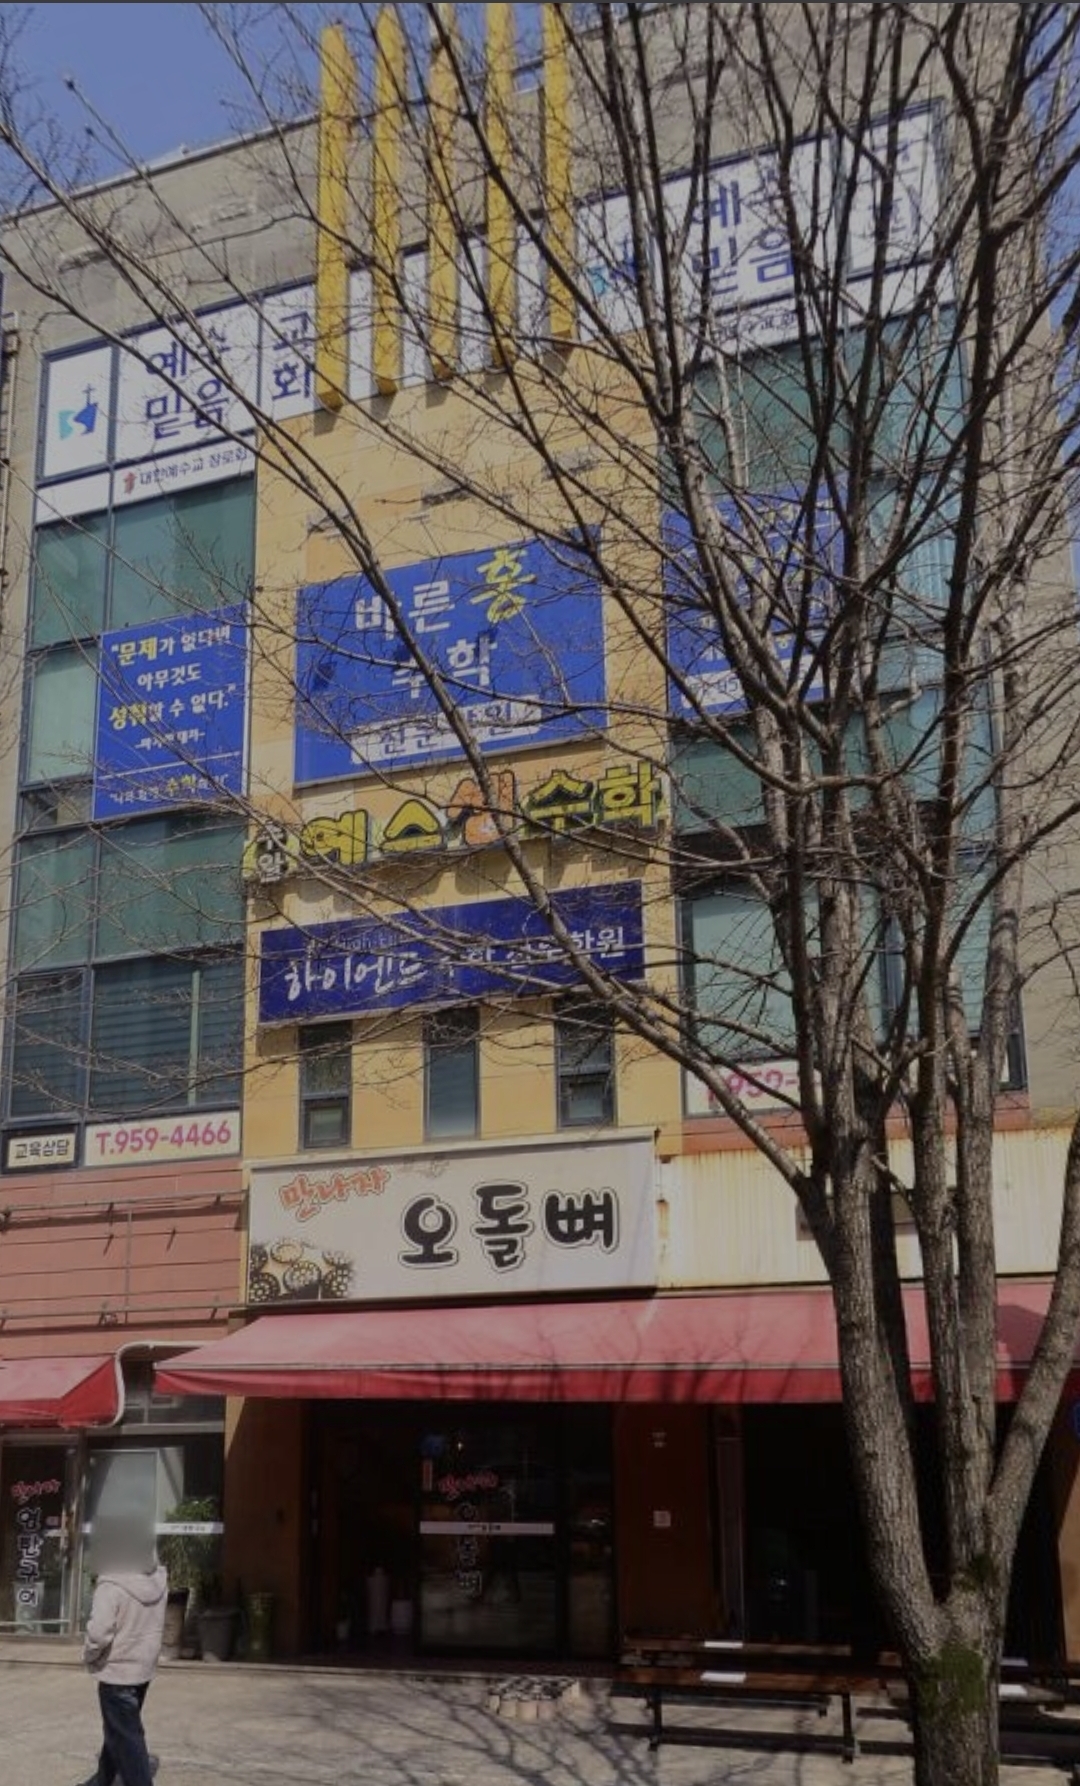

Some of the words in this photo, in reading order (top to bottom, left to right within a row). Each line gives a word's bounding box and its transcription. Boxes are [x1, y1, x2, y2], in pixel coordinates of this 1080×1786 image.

[146, 378, 231, 440] 믿음
[354, 580, 455, 641] 바른
[470, 549, 537, 624] 홍
[137, 663, 202, 692] 아무것도
[169, 699, 185, 717] 수
[379, 701, 513, 755] 전문원
[284, 943, 428, 1001] 하이엔드
[14, 1137, 71, 1160] 교육상담
[95, 1120, 232, 1156] T.959-4466
[401, 1183, 618, 1269] 오돌뼈
